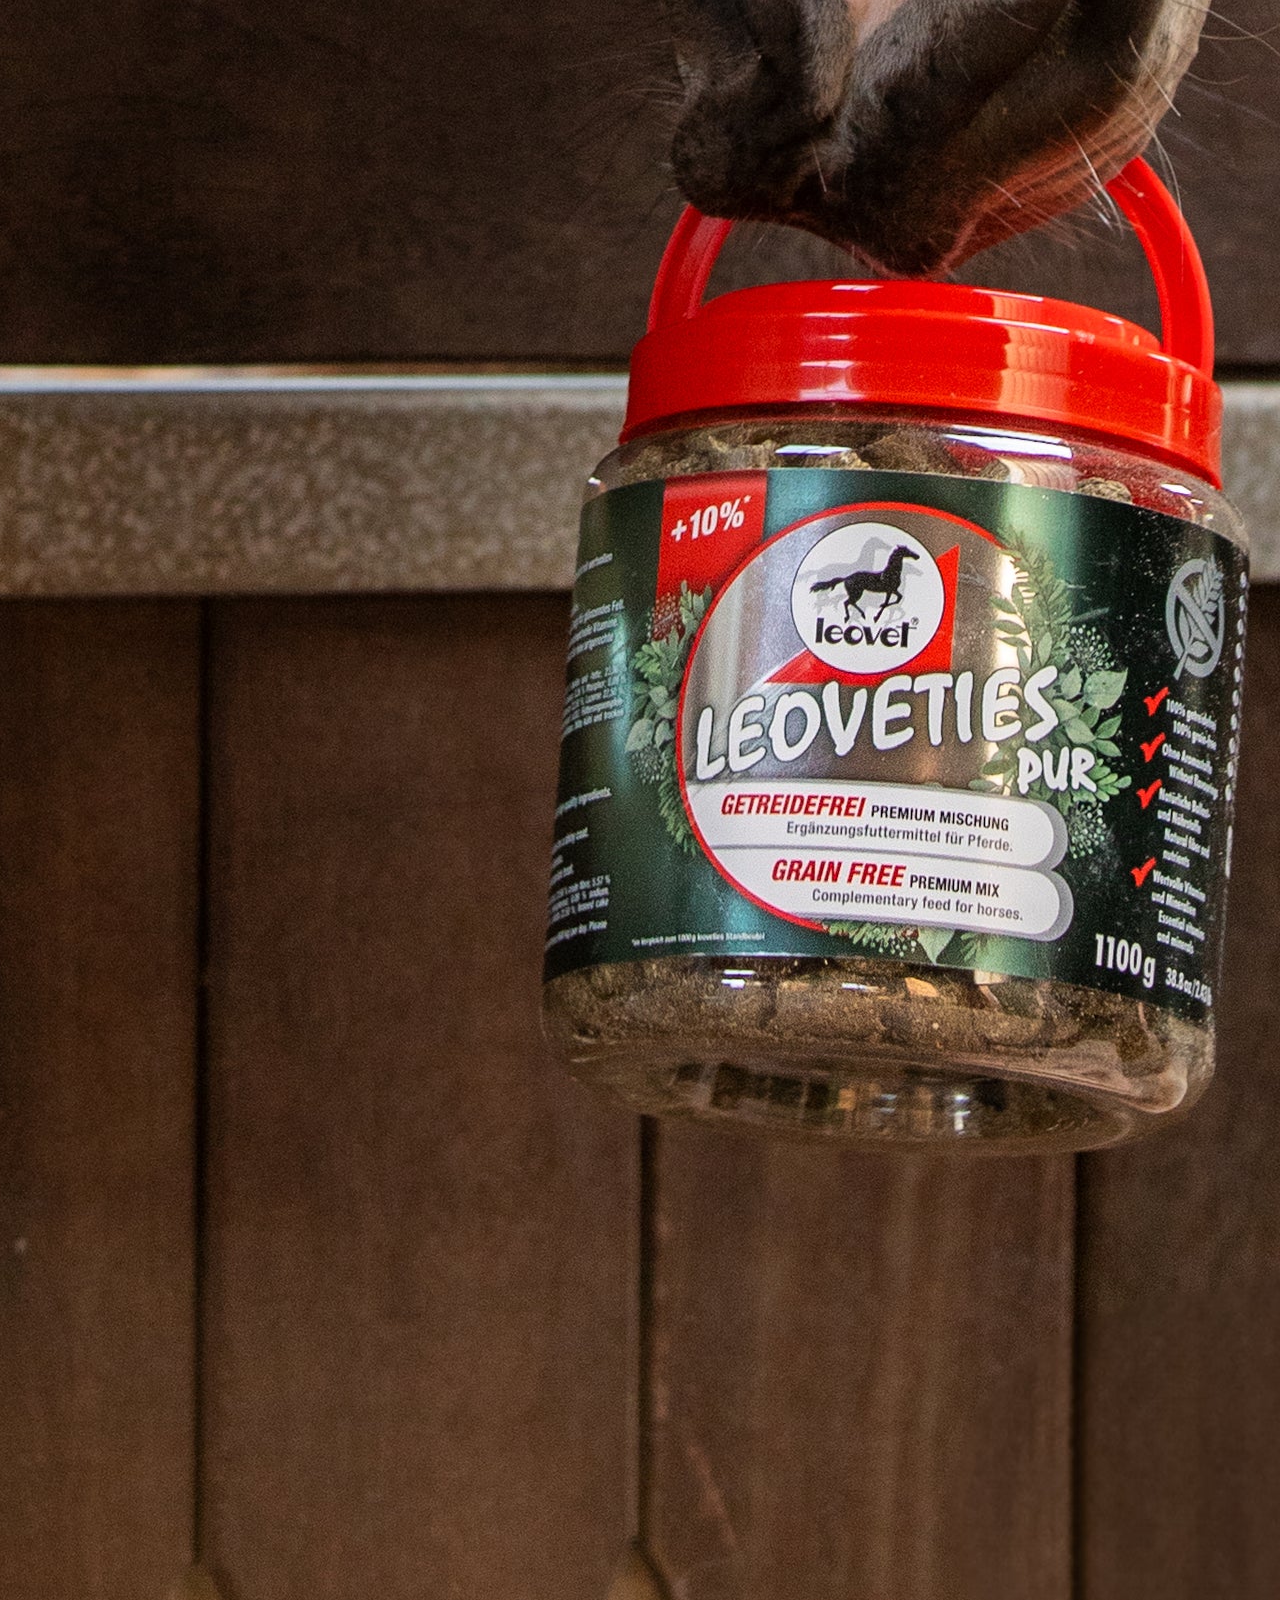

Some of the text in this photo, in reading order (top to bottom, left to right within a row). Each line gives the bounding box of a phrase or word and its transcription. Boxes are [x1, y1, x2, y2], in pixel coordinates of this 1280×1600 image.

[696, 665, 1059, 780] LEOVETIES
[1017, 746, 1097, 795] PUR
[721, 794, 1009, 832] GETREIDEFREI PREMIUM MISCHUNG
[786, 821, 1014, 853] Ergänzungsfuttermittel für Pferde.
[771, 859, 1000, 898] GRAIN FREE PREMIUM MIX
[812, 888, 1024, 921] Complementary feed for horses.
